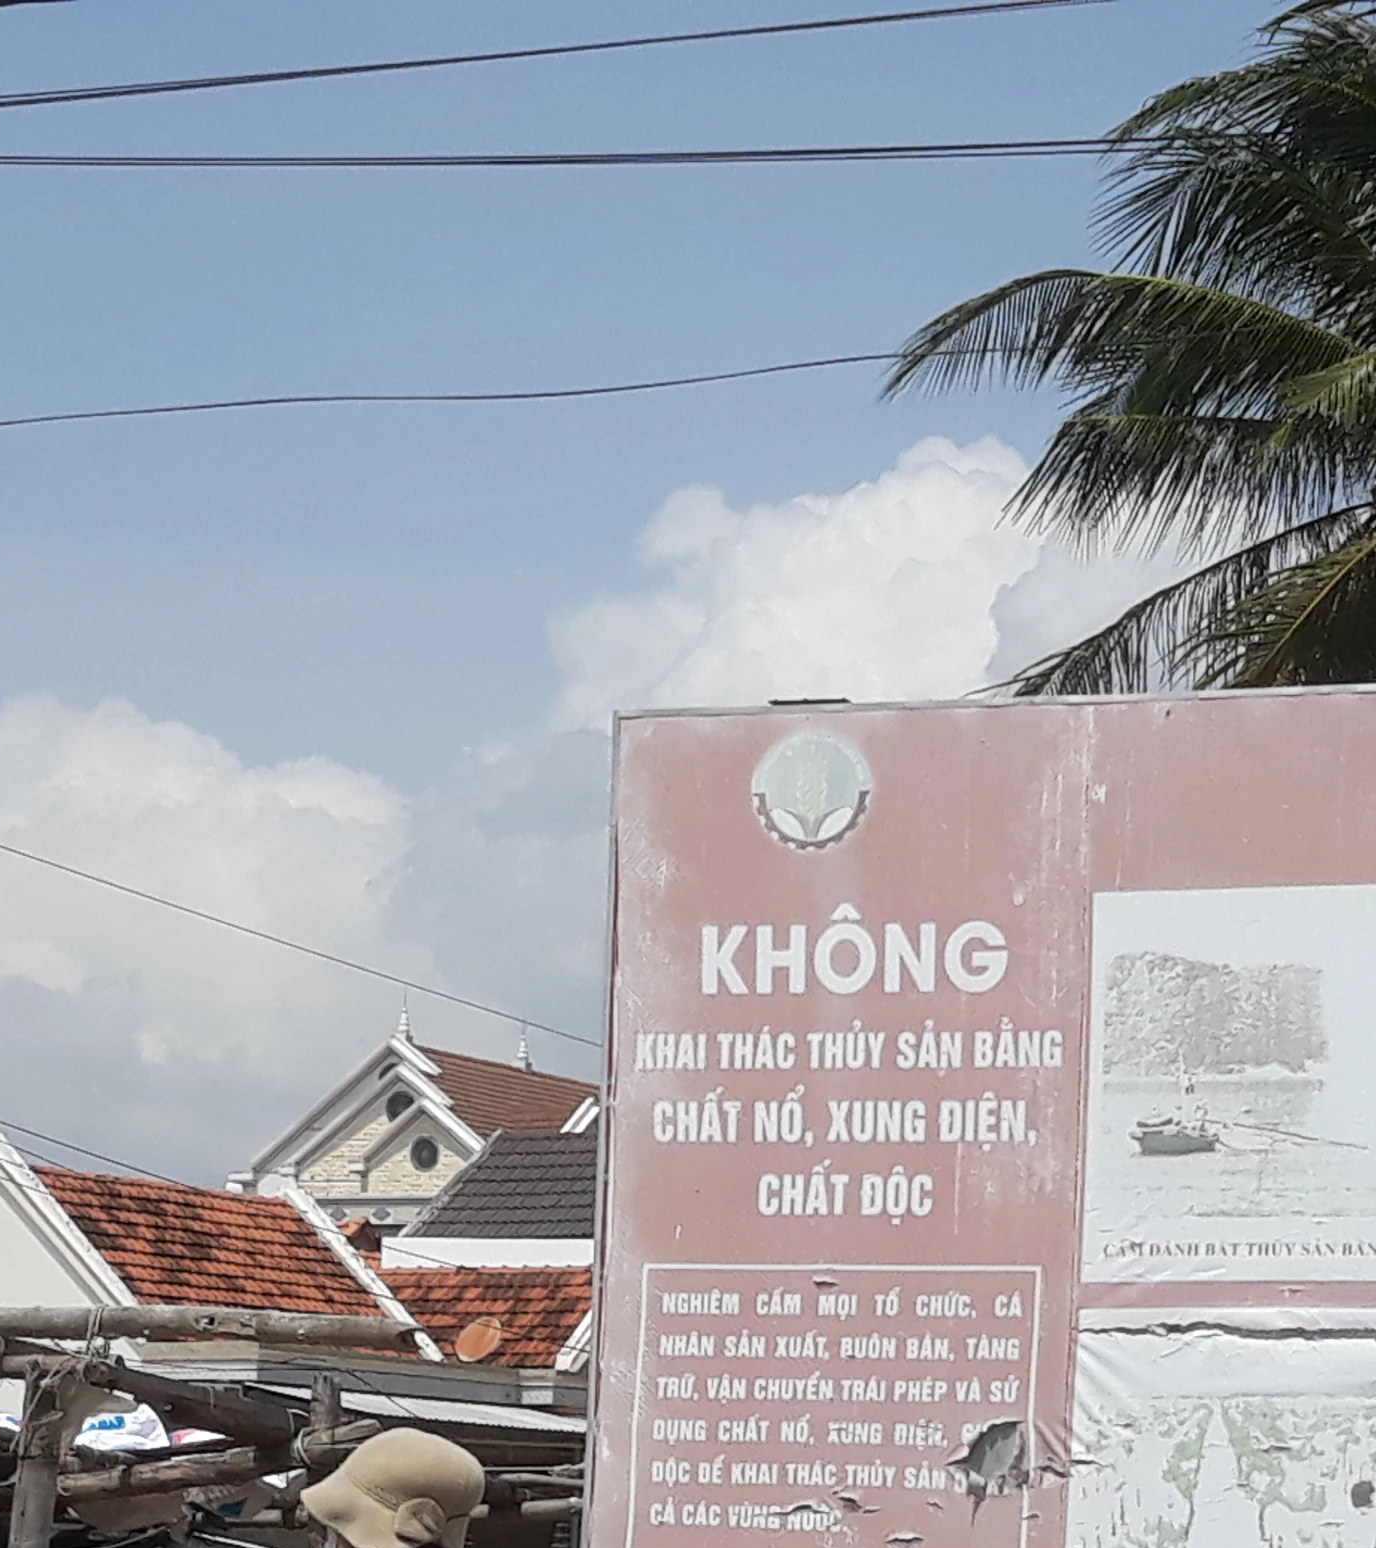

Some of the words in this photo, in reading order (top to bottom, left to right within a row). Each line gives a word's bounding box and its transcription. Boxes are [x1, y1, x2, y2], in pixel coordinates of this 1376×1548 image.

[701, 903, 1008, 995] KHÔNG
[636, 1032, 707, 1070] KHAI
[717, 1025, 796, 1070] THÁC
[807, 1018, 886, 1070] THỦY
[896, 1019, 963, 1070] SẢN
[974, 1016, 1063, 1069] BẰNG
[653, 1085, 742, 1143] CHẤT
[754, 1084, 814, 1148] NỔ,
[827, 1099, 926, 1143] XUNG
[938, 1091, 1038, 1151] ĐIỆN,
[758, 1159, 849, 1217] CHẤT
[860, 1166, 933, 1225] ĐỘC
[662, 1288, 739, 1315] NGHIÊM
[756, 1287, 801, 1315] CẤM
[818, 1293, 858, 1320] MỌI
[874, 1287, 901, 1316] TỔ
[915, 1291, 976, 1320] CHỨC,
[994, 1289, 1022, 1317] CÁ
[660, 1331, 715, 1357] NHÂN
[725, 1329, 766, 1358] SẢN
[840, 1332, 896, 1359] BUÔN
[906, 1330, 955, 1361] BÁN,
[707, 1374, 746, 1404] VẬN
[754, 1371, 833, 1401] CHUYỂN
[841, 1376, 886, 1402] TRÁI
[893, 1376, 947, 1403] PHÉP
[955, 1377, 981, 1403] VÀ
[990, 1375, 1020, 1403] SỬ
[652, 1419, 707, 1445] DỤNG
[718, 1414, 770, 1442] CHẤT
[827, 1422, 882, 1444] XUNG
[652, 1457, 690, 1487] ĐỘC
[731, 1463, 778, 1485] KHAI
[786, 1460, 837, 1487] THÁC
[845, 1460, 896, 1489] THỦY
[904, 1461, 947, 1491] SẢN
[682, 1501, 721, 1526] CÁC
